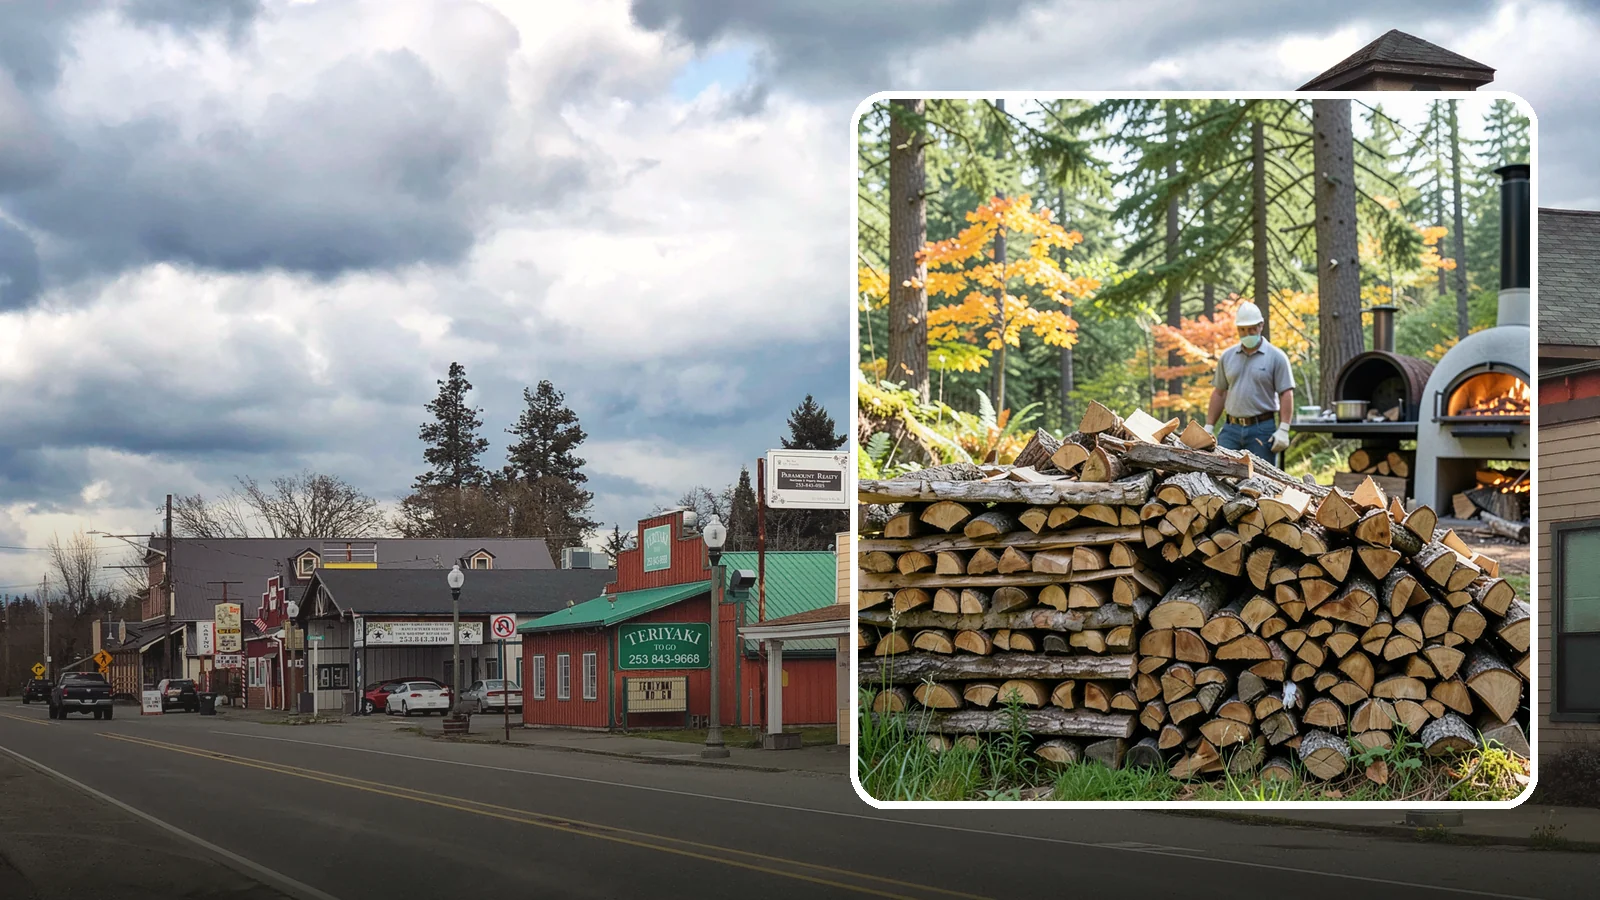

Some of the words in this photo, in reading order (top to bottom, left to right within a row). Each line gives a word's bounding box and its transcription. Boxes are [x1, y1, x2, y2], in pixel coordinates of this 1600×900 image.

[625, 628, 702, 646] TERIYAKI
[629, 654, 648, 664] 253
[652, 654, 700, 664] 843-9668
